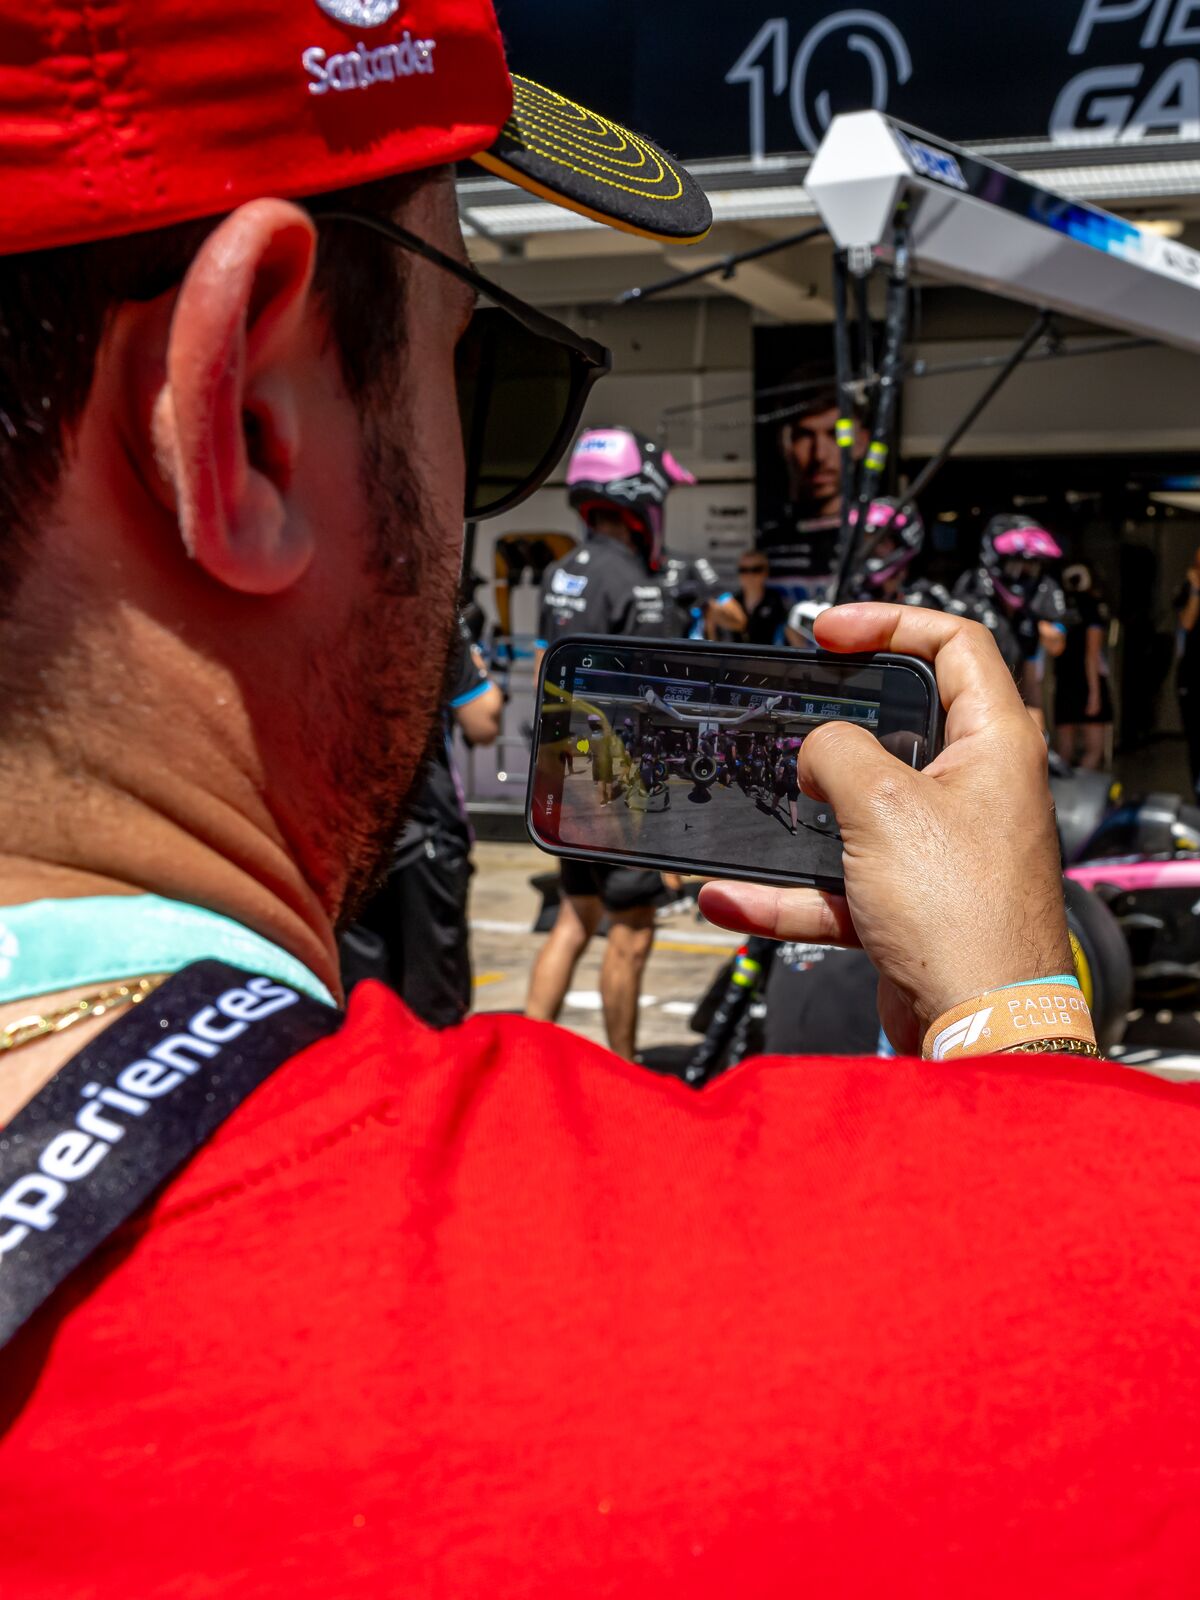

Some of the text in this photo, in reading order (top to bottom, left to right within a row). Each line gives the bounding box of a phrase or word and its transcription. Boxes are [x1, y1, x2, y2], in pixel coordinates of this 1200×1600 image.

[302, 30, 437, 95] Santander
[724, 8, 913, 170] 10
[805, 703, 814, 714] 18
[1008, 996, 1091, 1016] PADDOC
[1013, 1012, 1072, 1029] CLUB
